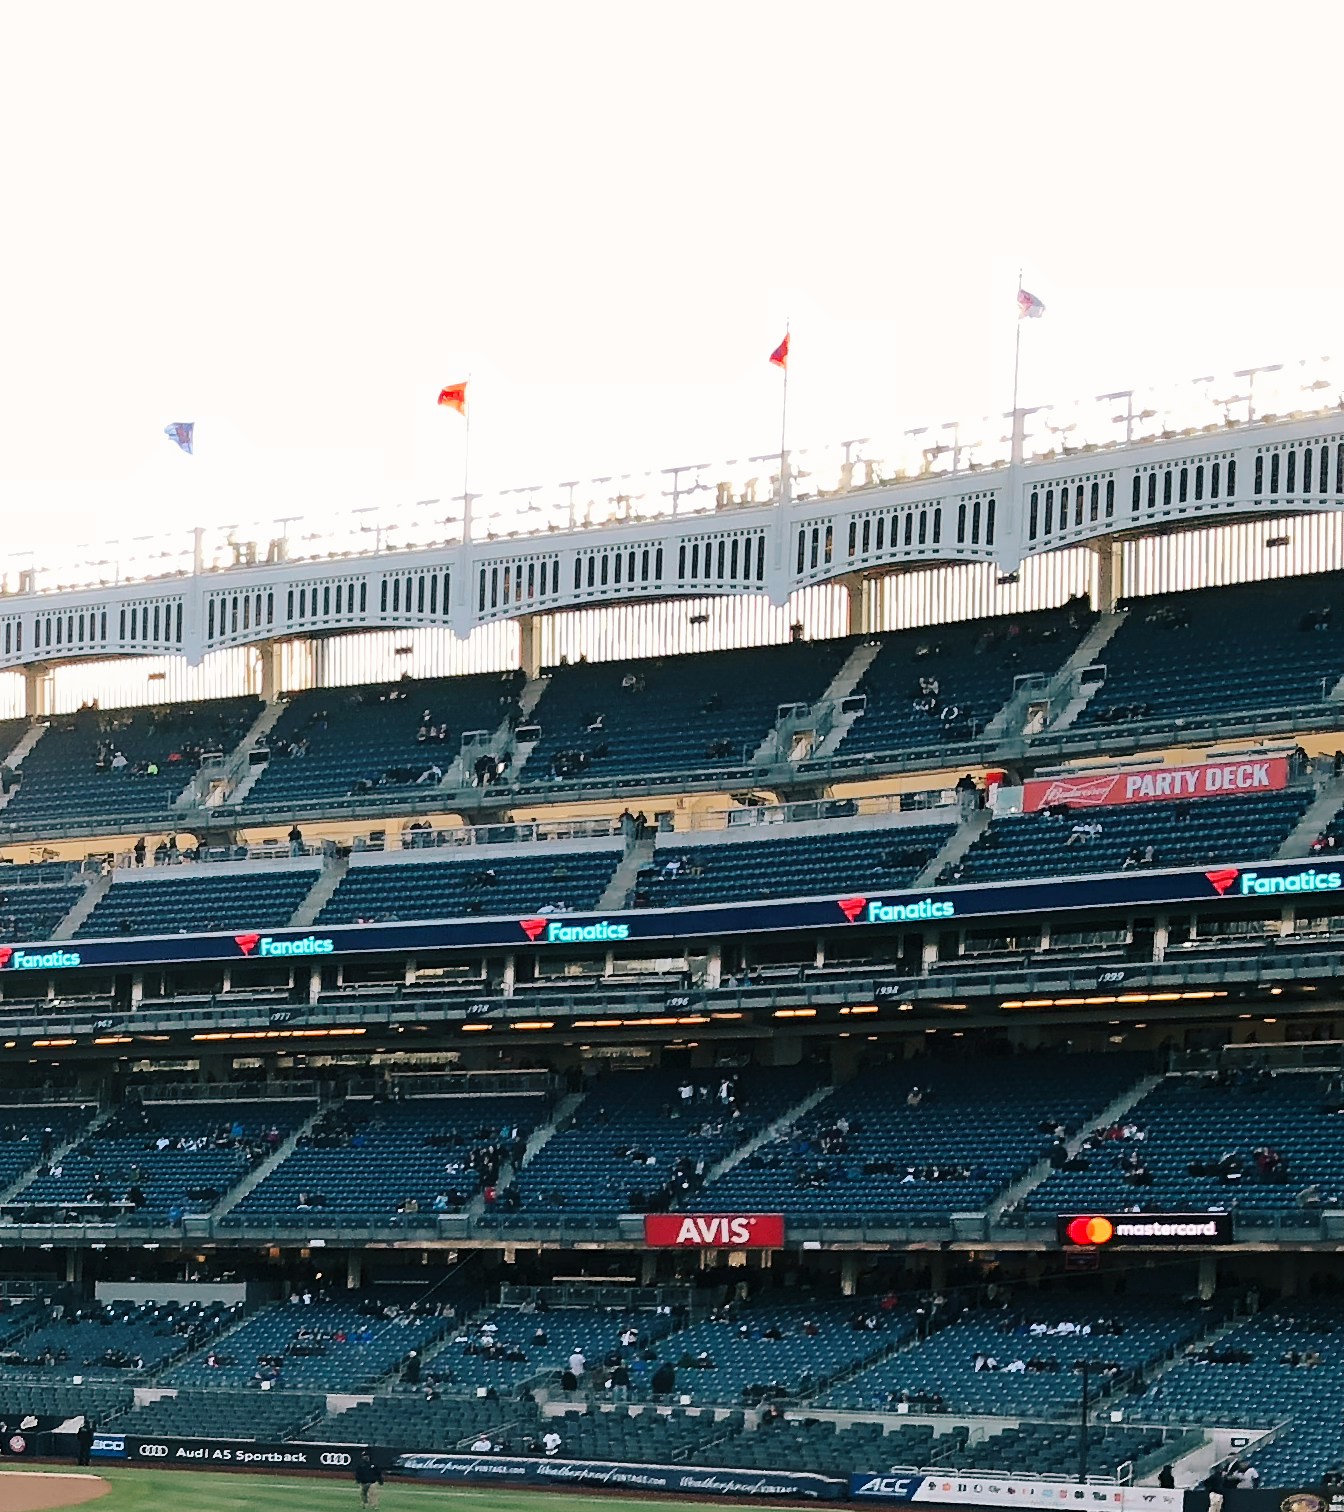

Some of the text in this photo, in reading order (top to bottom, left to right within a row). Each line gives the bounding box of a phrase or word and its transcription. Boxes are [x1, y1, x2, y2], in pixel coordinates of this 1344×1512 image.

[1126, 762, 1271, 799] PARTY DECK
[1241, 869, 1343, 895] Fanatics
[869, 899, 955, 922] Fanatics
[548, 921, 630, 943] Fanatics
[260, 936, 334, 957] Fanatics
[14, 950, 81, 970] Fanatics
[675, 1216, 750, 1244] AVIS
[91, 1439, 124, 1451] EICO
[176, 1447, 307, 1463] Audi A5 Sportback
[405, 1458, 480, 1476] Weatherproof
[537, 1464, 617, 1483] Weatherproof
[679, 1475, 766, 1495] Weatherproof
[860, 1477, 912, 1493] ACC
